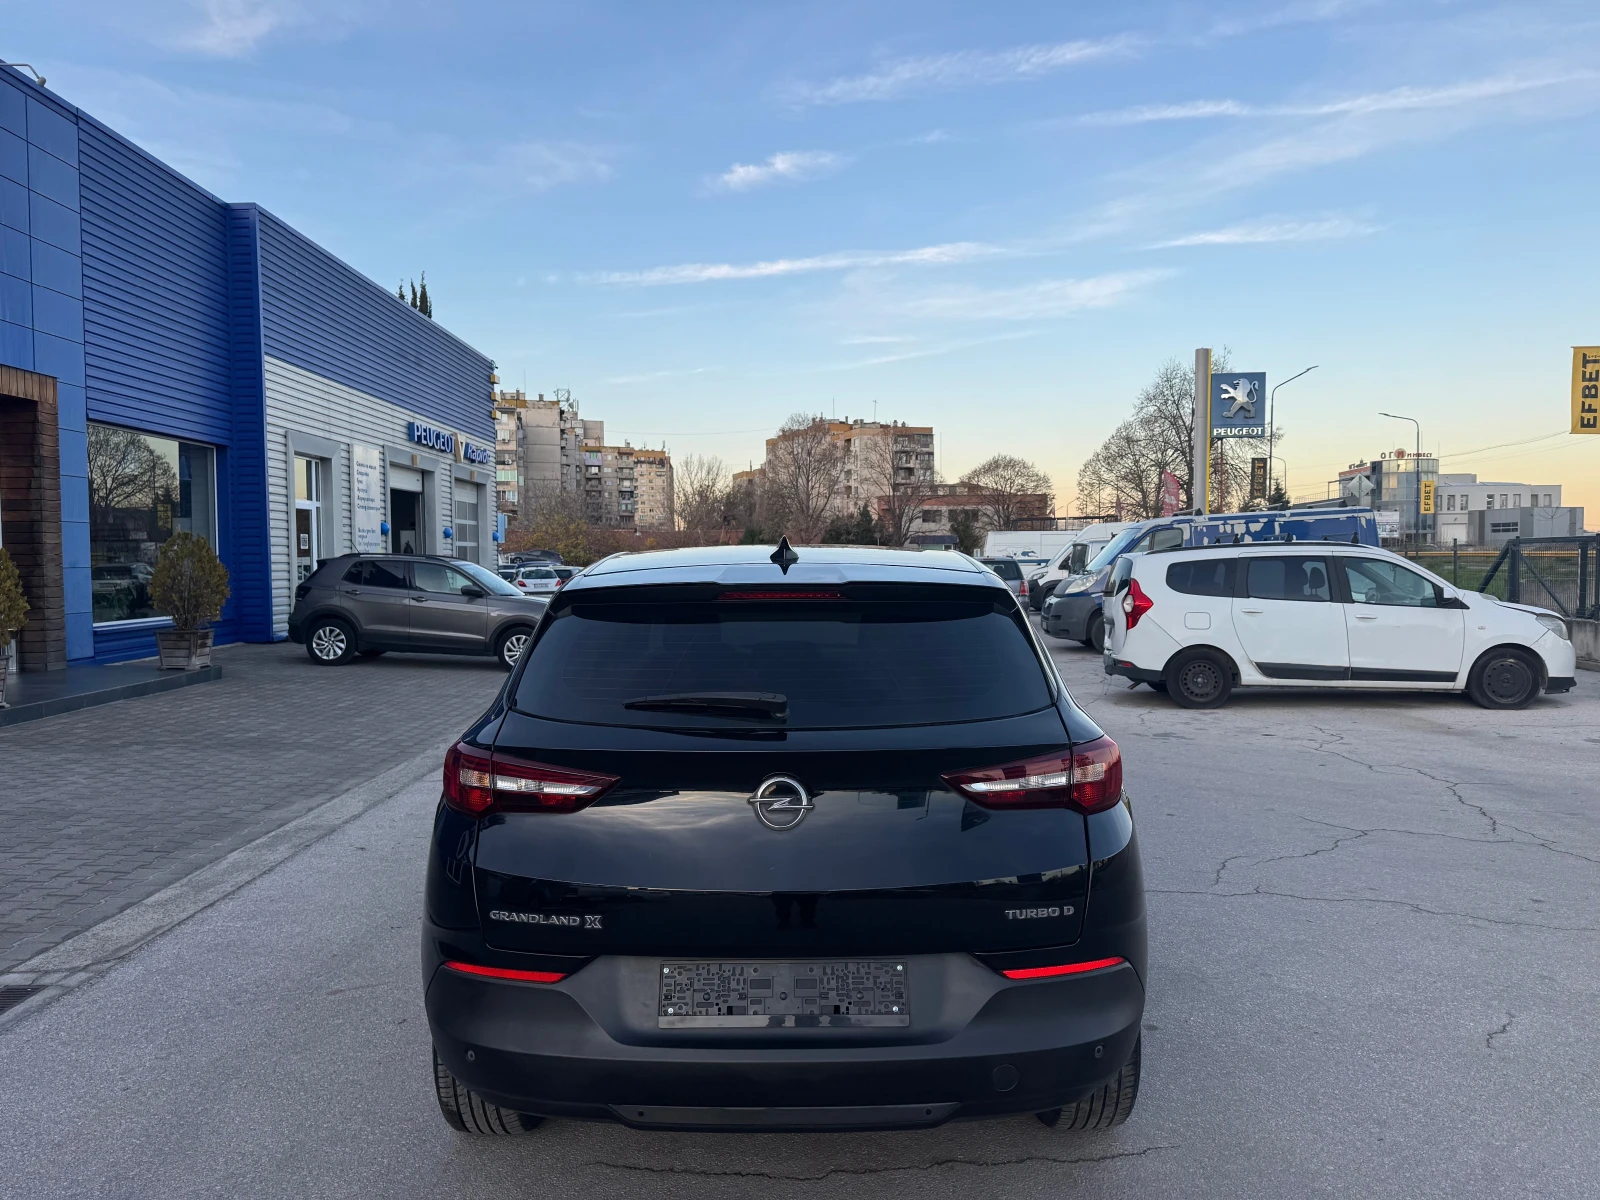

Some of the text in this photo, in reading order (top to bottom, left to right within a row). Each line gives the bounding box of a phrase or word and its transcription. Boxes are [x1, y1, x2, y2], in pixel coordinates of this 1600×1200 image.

[1580, 352, 1600, 428] EFBET
[414, 422, 455, 453] PEUGEOT
[1213, 426, 1263, 436] PEUGEOT
[489, 910, 602, 929] GRANDLAND X
[1005, 905, 1075, 920] TURBO D
